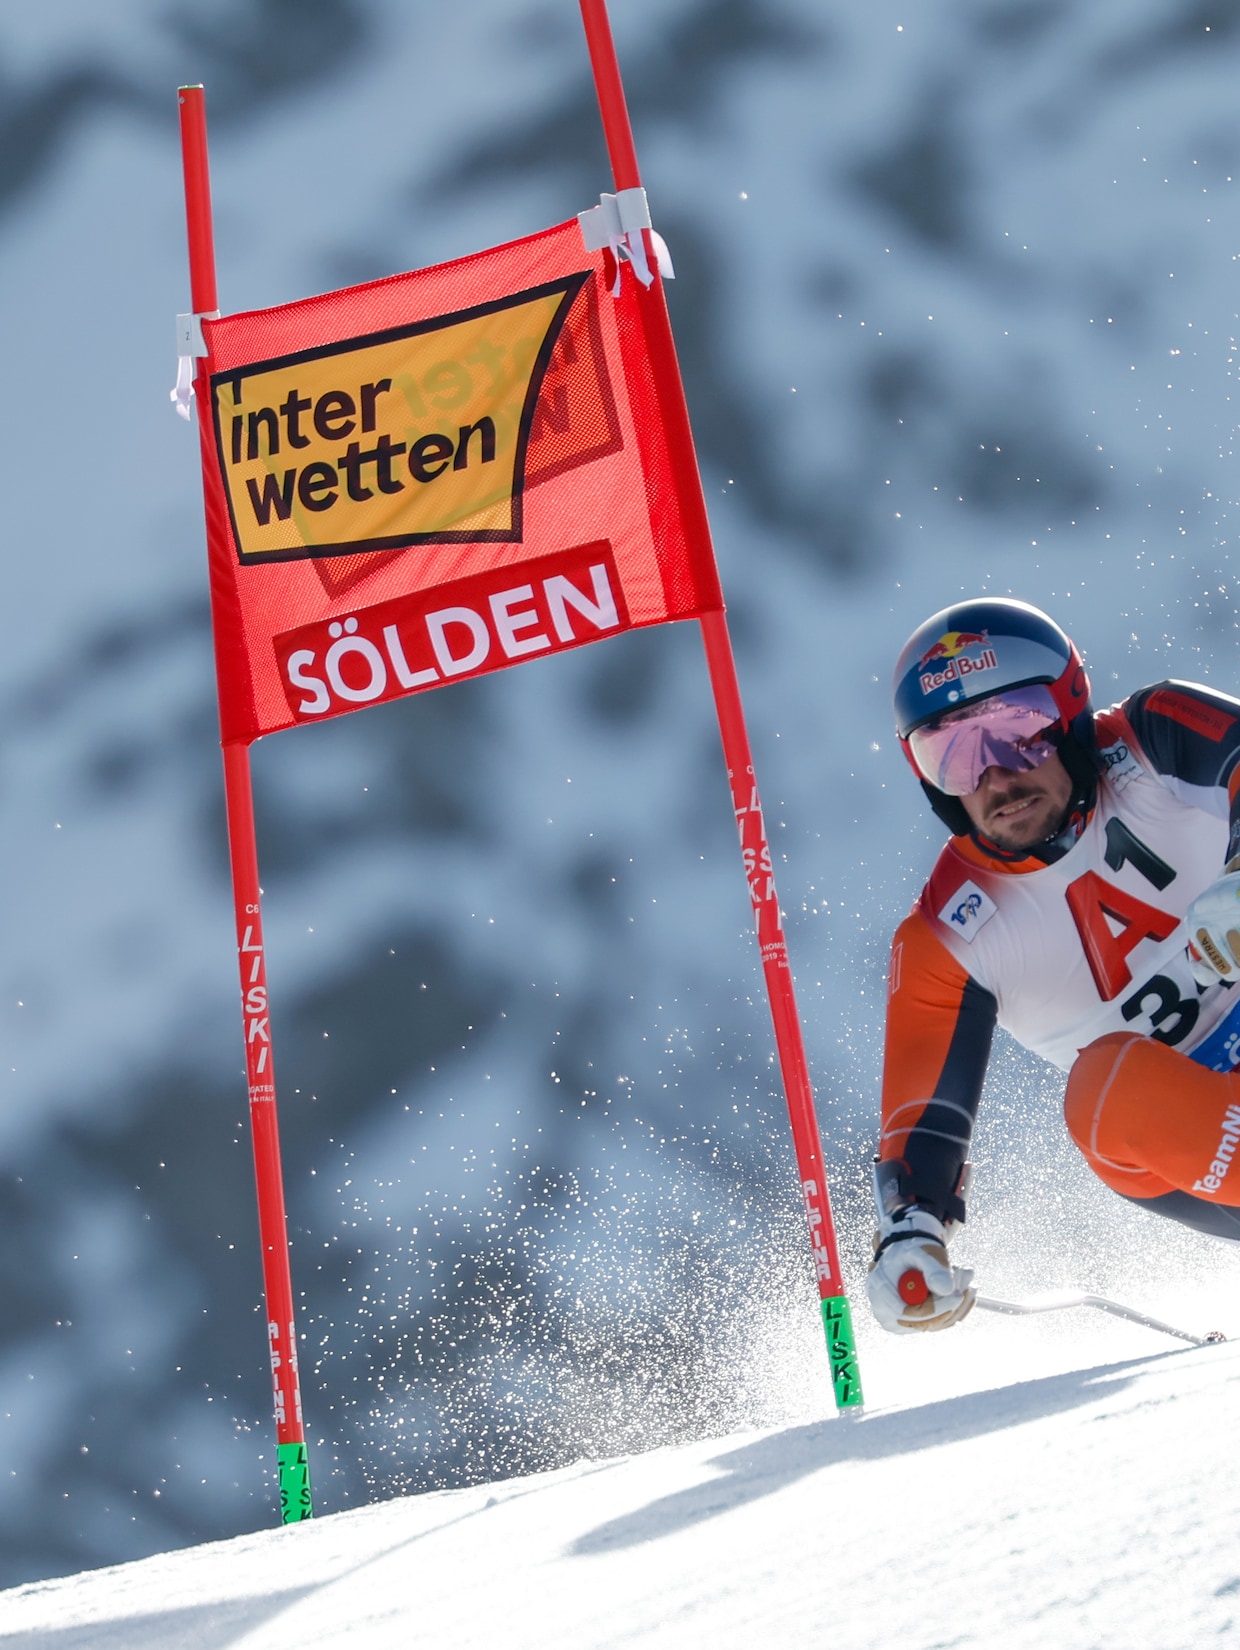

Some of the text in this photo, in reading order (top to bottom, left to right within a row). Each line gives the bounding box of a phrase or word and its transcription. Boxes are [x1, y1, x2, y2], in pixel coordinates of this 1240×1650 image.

[231, 378, 393, 465] inter
[245, 414, 497, 527] wetten
[286, 563, 621, 714] SÖLDEN
[919, 648, 998, 696] Red Bull
[245, 904, 259, 914] C6
[1201, 936, 1226, 971] HESTRA
[242, 925, 270, 1074] LISKI
[803, 1179, 831, 1281] ALPINA
[268, 1322, 286, 1424] ALPINA
[826, 1301, 853, 1403] LISKI
